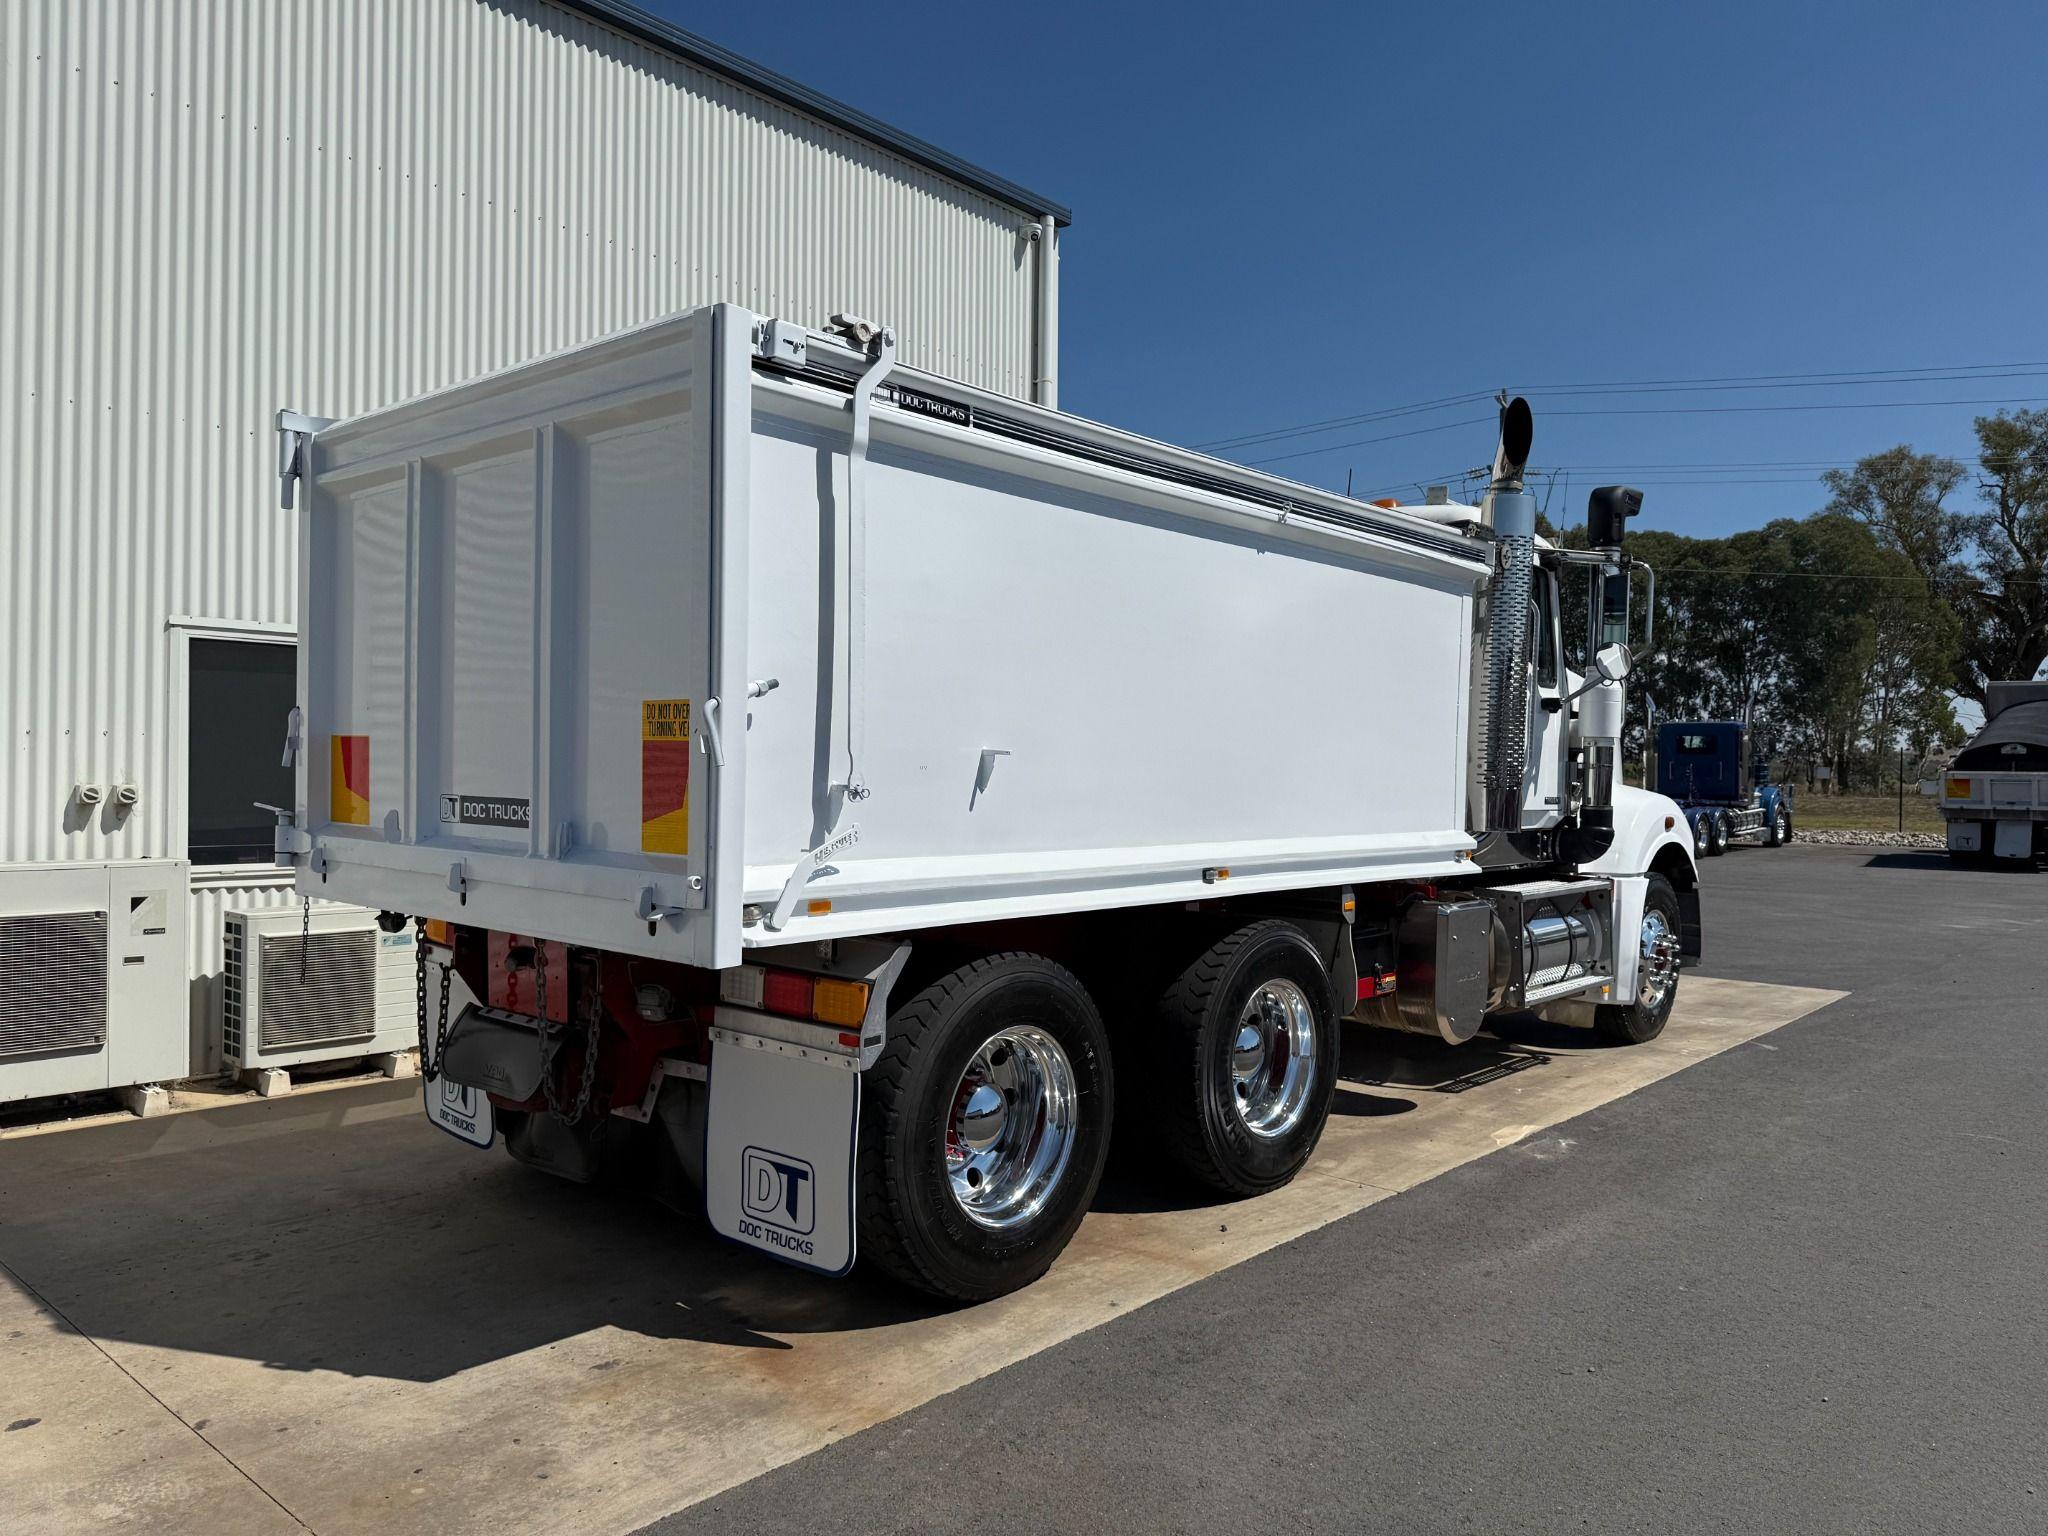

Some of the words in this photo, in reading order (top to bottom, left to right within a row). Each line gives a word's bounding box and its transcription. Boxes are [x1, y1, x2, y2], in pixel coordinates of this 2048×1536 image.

[925, 400, 966, 421] TRUCKS
[646, 703, 656, 720] DO
[658, 703, 671, 720] NOT
[648, 720, 677, 737] TURNING
[463, 802, 486, 818] DOC
[439, 1108, 451, 1123] DOC
[450, 1113, 476, 1134] TRUCKS
[748, 1154, 809, 1224] DT
[739, 1219, 762, 1239] DOC
[765, 1228, 814, 1256] TRUCKS
